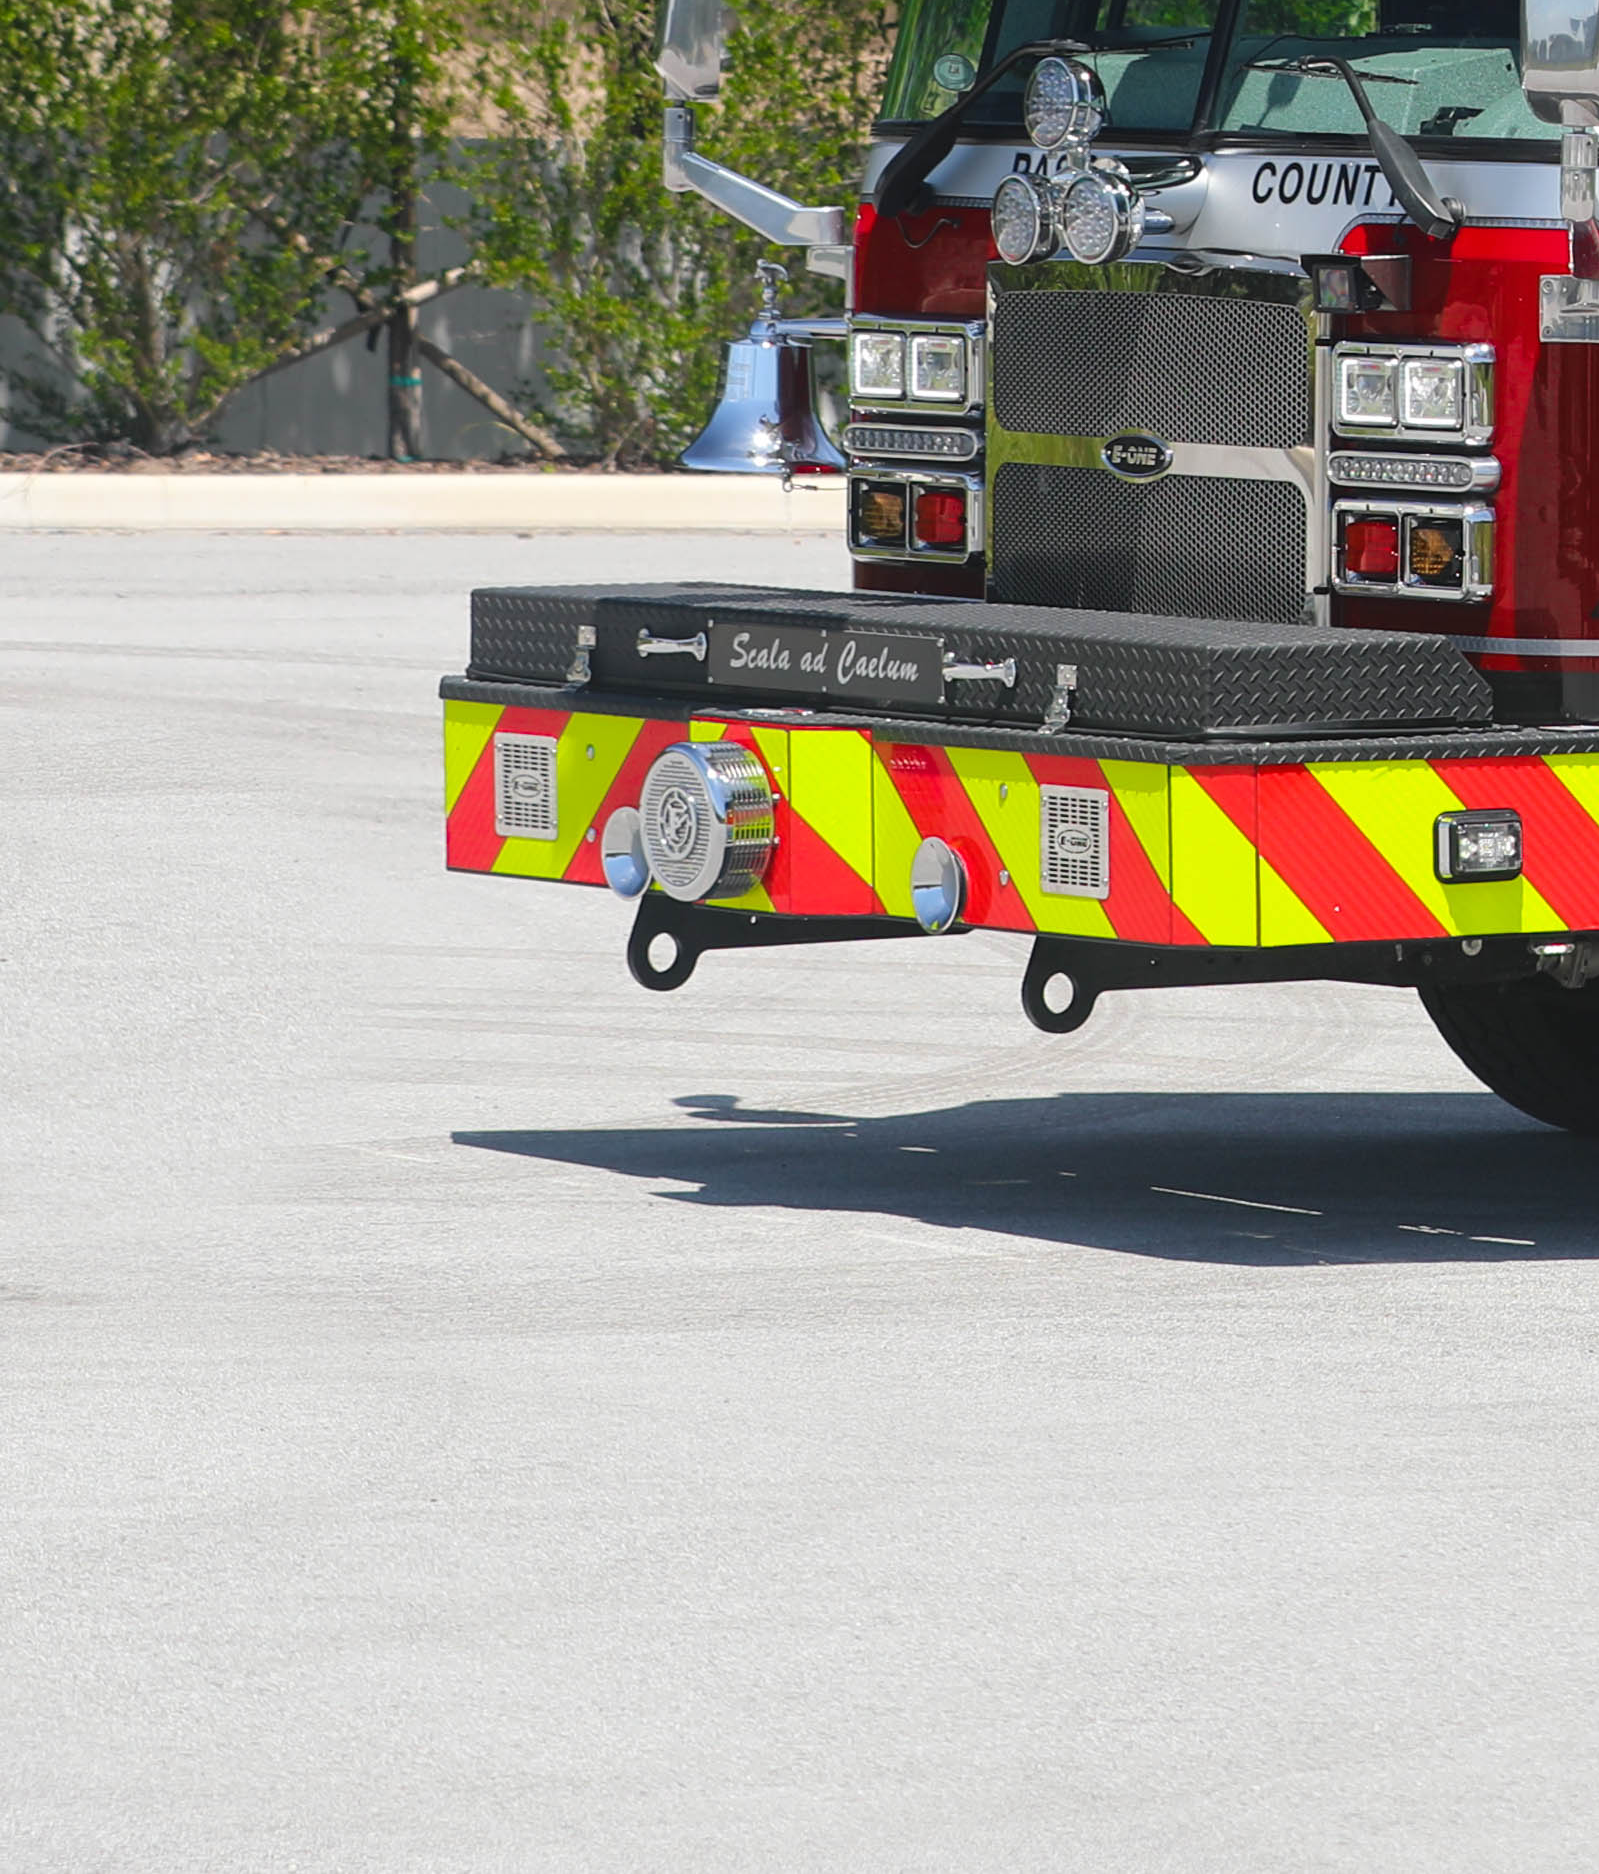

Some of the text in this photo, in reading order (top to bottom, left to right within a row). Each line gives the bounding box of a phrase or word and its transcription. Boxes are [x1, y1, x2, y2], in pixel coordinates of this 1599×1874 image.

[1252, 161, 1399, 208] COUNT
[1111, 444, 1158, 466] E-ONE
[730, 632, 919, 685] Scala ad Caelum
